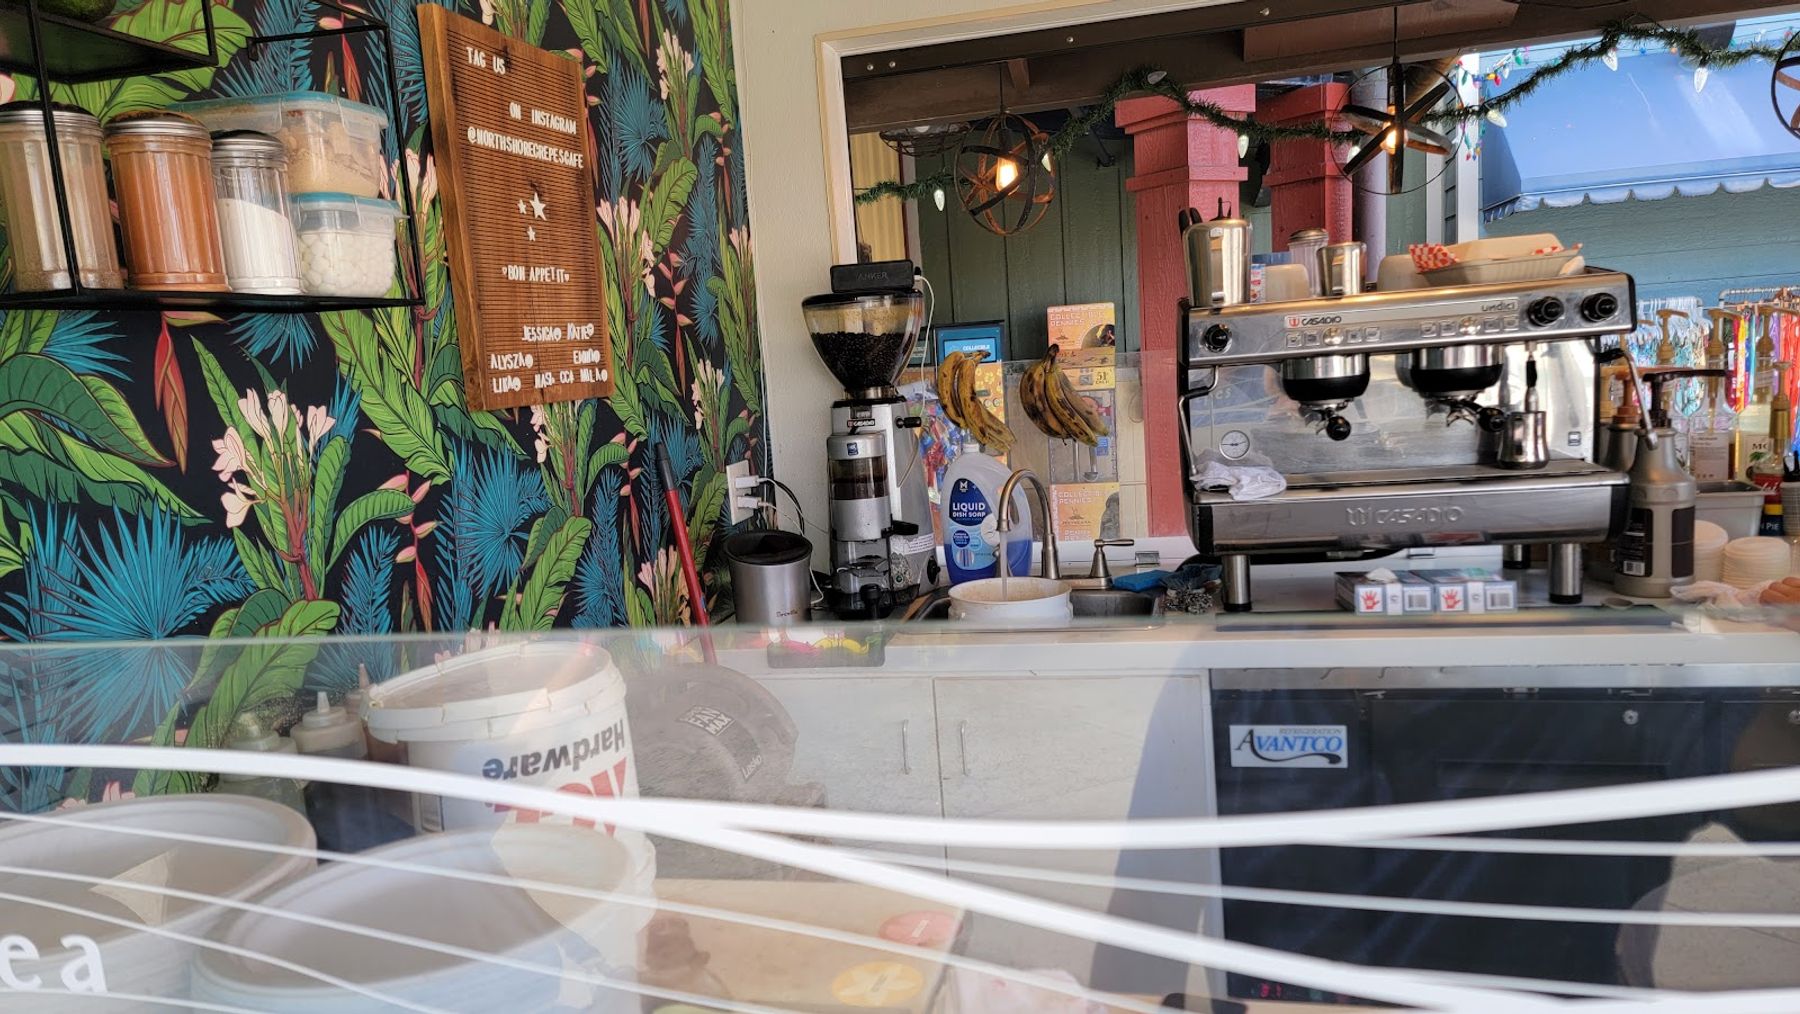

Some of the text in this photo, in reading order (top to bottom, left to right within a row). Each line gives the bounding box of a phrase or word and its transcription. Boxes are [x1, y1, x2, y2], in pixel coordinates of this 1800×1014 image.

[466, 46, 506, 75] TAG US
[509, 101, 577, 135] ON INSTAGRAM
[467, 126, 584, 169] @NORTHSHORECREPESCAFE
[507, 264, 565, 283] BON APPETIT
[856, 271, 889, 281] ANKER
[1301, 315, 1342, 326] CASADIO
[952, 502, 986, 512] LIQUID
[482, 718, 626, 780] Hardware
